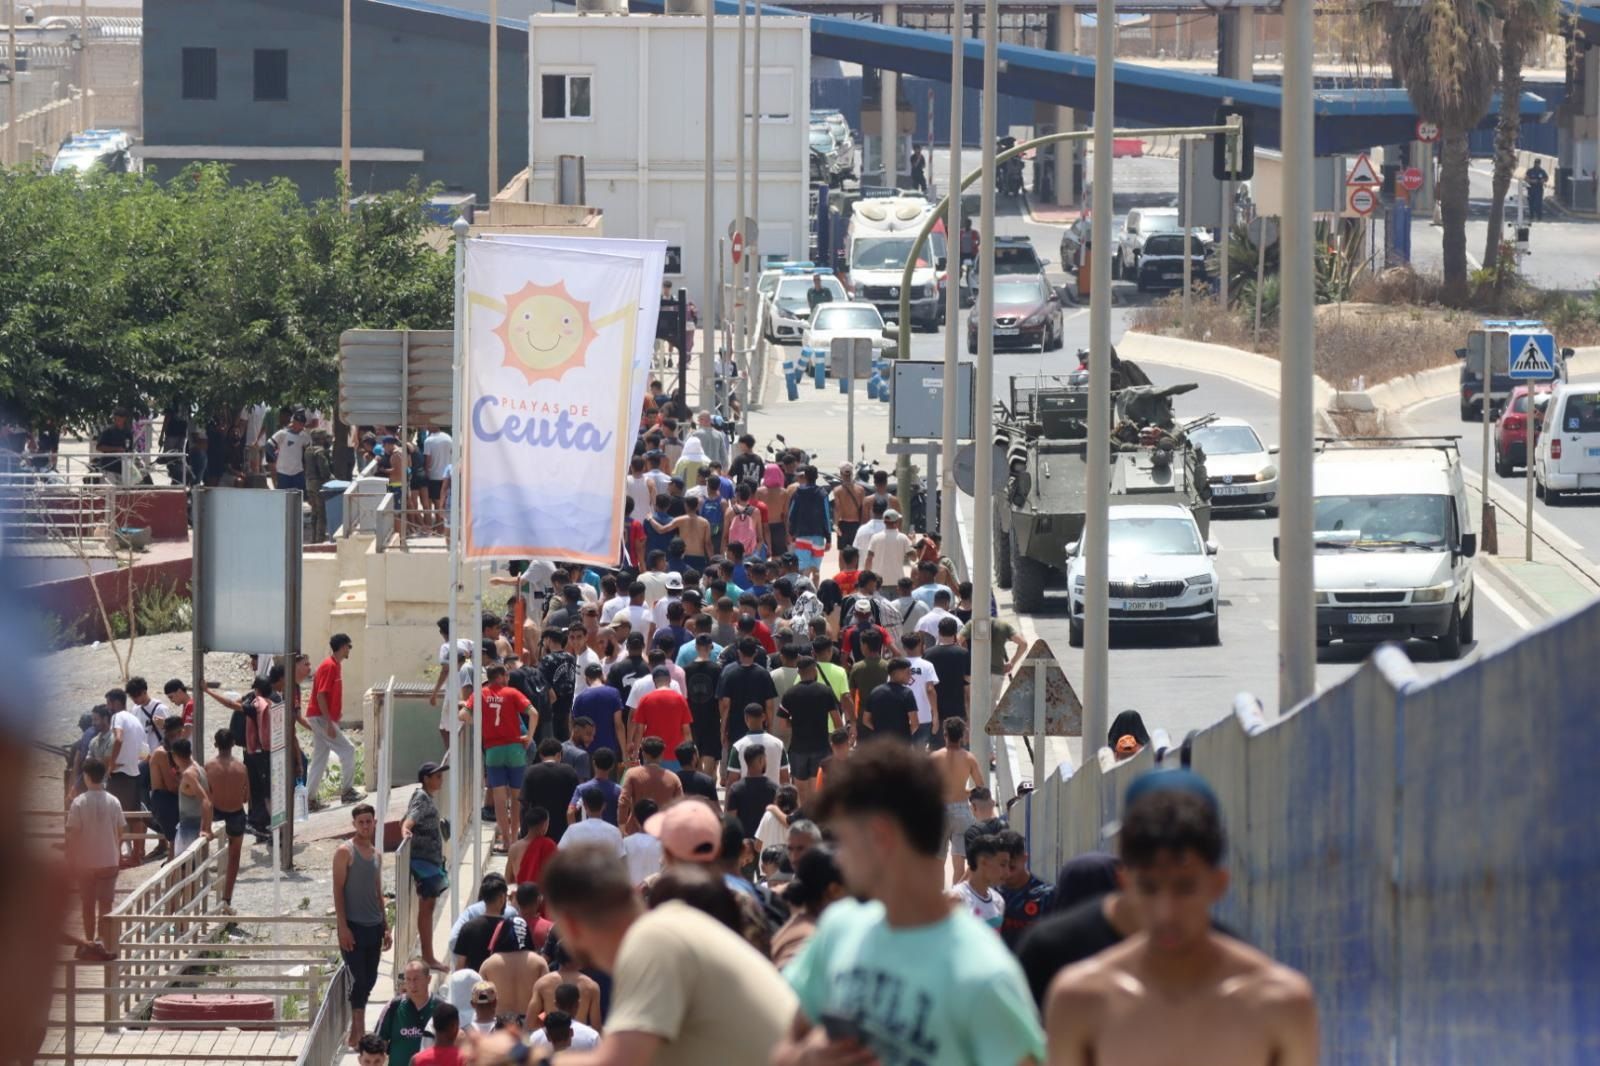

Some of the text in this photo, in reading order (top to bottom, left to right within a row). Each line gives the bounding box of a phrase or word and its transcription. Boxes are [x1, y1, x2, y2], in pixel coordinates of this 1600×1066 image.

[501, 397, 589, 417] PLAYAS DE
[472, 395, 612, 452] Ceuta
[488, 702, 502, 727] 7
